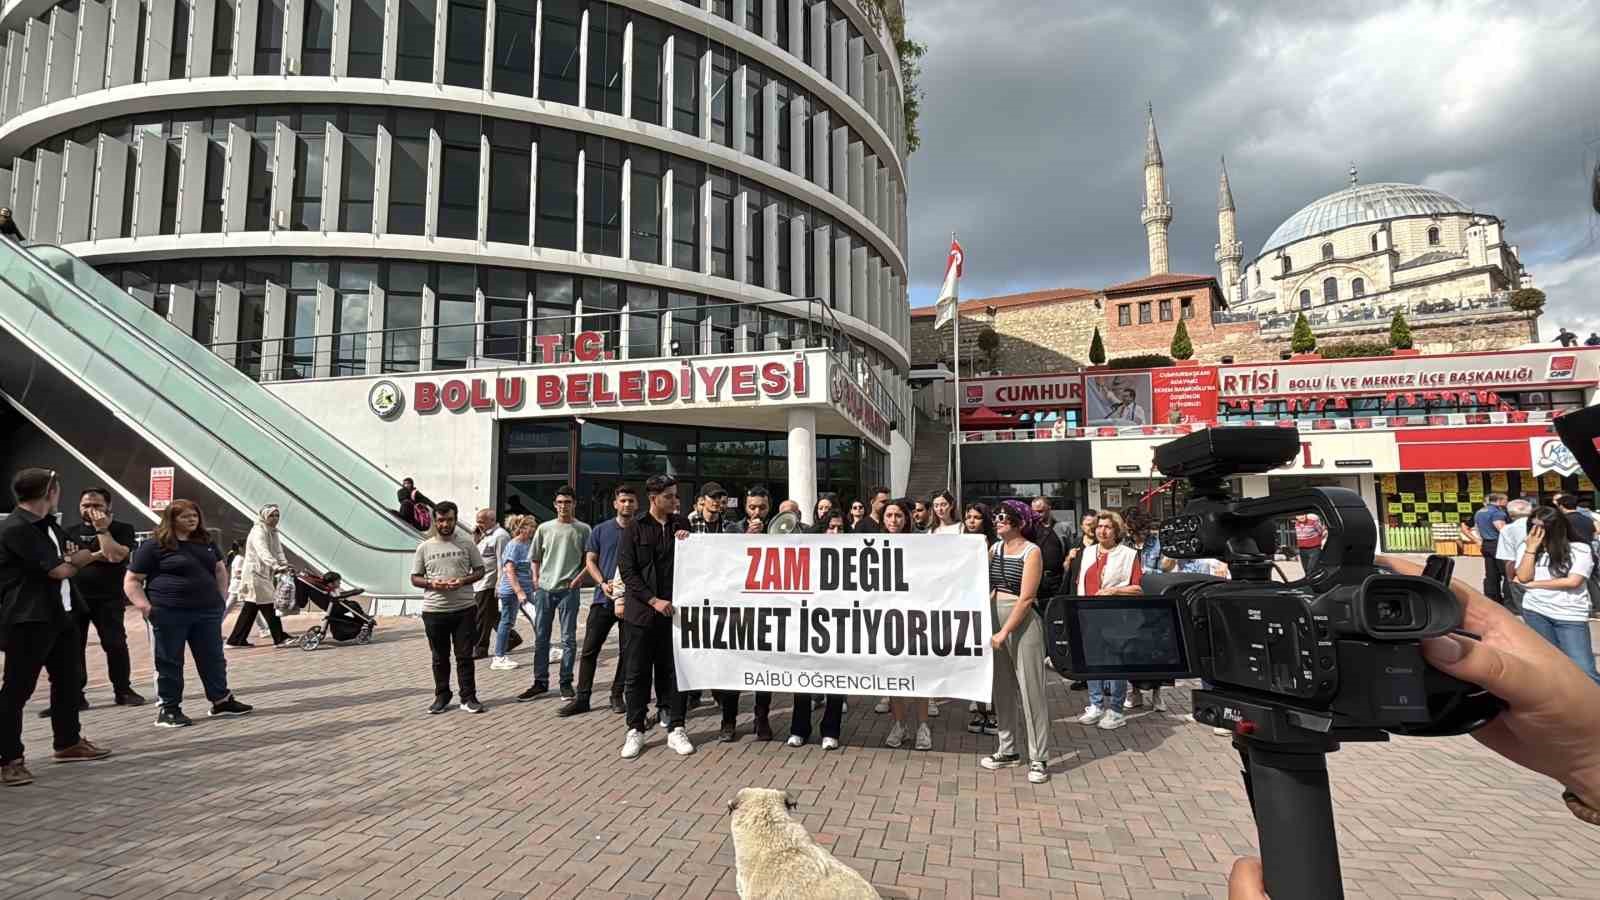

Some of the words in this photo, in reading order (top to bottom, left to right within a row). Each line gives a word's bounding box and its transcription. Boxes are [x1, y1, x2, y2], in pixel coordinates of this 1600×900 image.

[535, 330, 615, 364] T.C.
[413, 377, 524, 413] BOLU
[536, 352, 807, 405] BELEDİYESİ
[996, 383, 1083, 402] CUMHUR
[1288, 378, 1321, 390] BOLU
[1325, 375, 1337, 388] İL
[1340, 377, 1357, 387] VE
[1361, 374, 1415, 387] MERKEZ
[1418, 371, 1446, 385] İLÇE
[1449, 367, 1533, 384] BAŞKANLIĞI
[744, 547, 811, 592] ZAM
[819, 538, 909, 592] DEĞİL
[680, 598, 792, 653] HİZMET
[799, 600, 984, 657] İSTİYORUZ!
[744, 671, 793, 687] BAİBÜ
[799, 672, 916, 692] ÖĞRENCİLERİ
